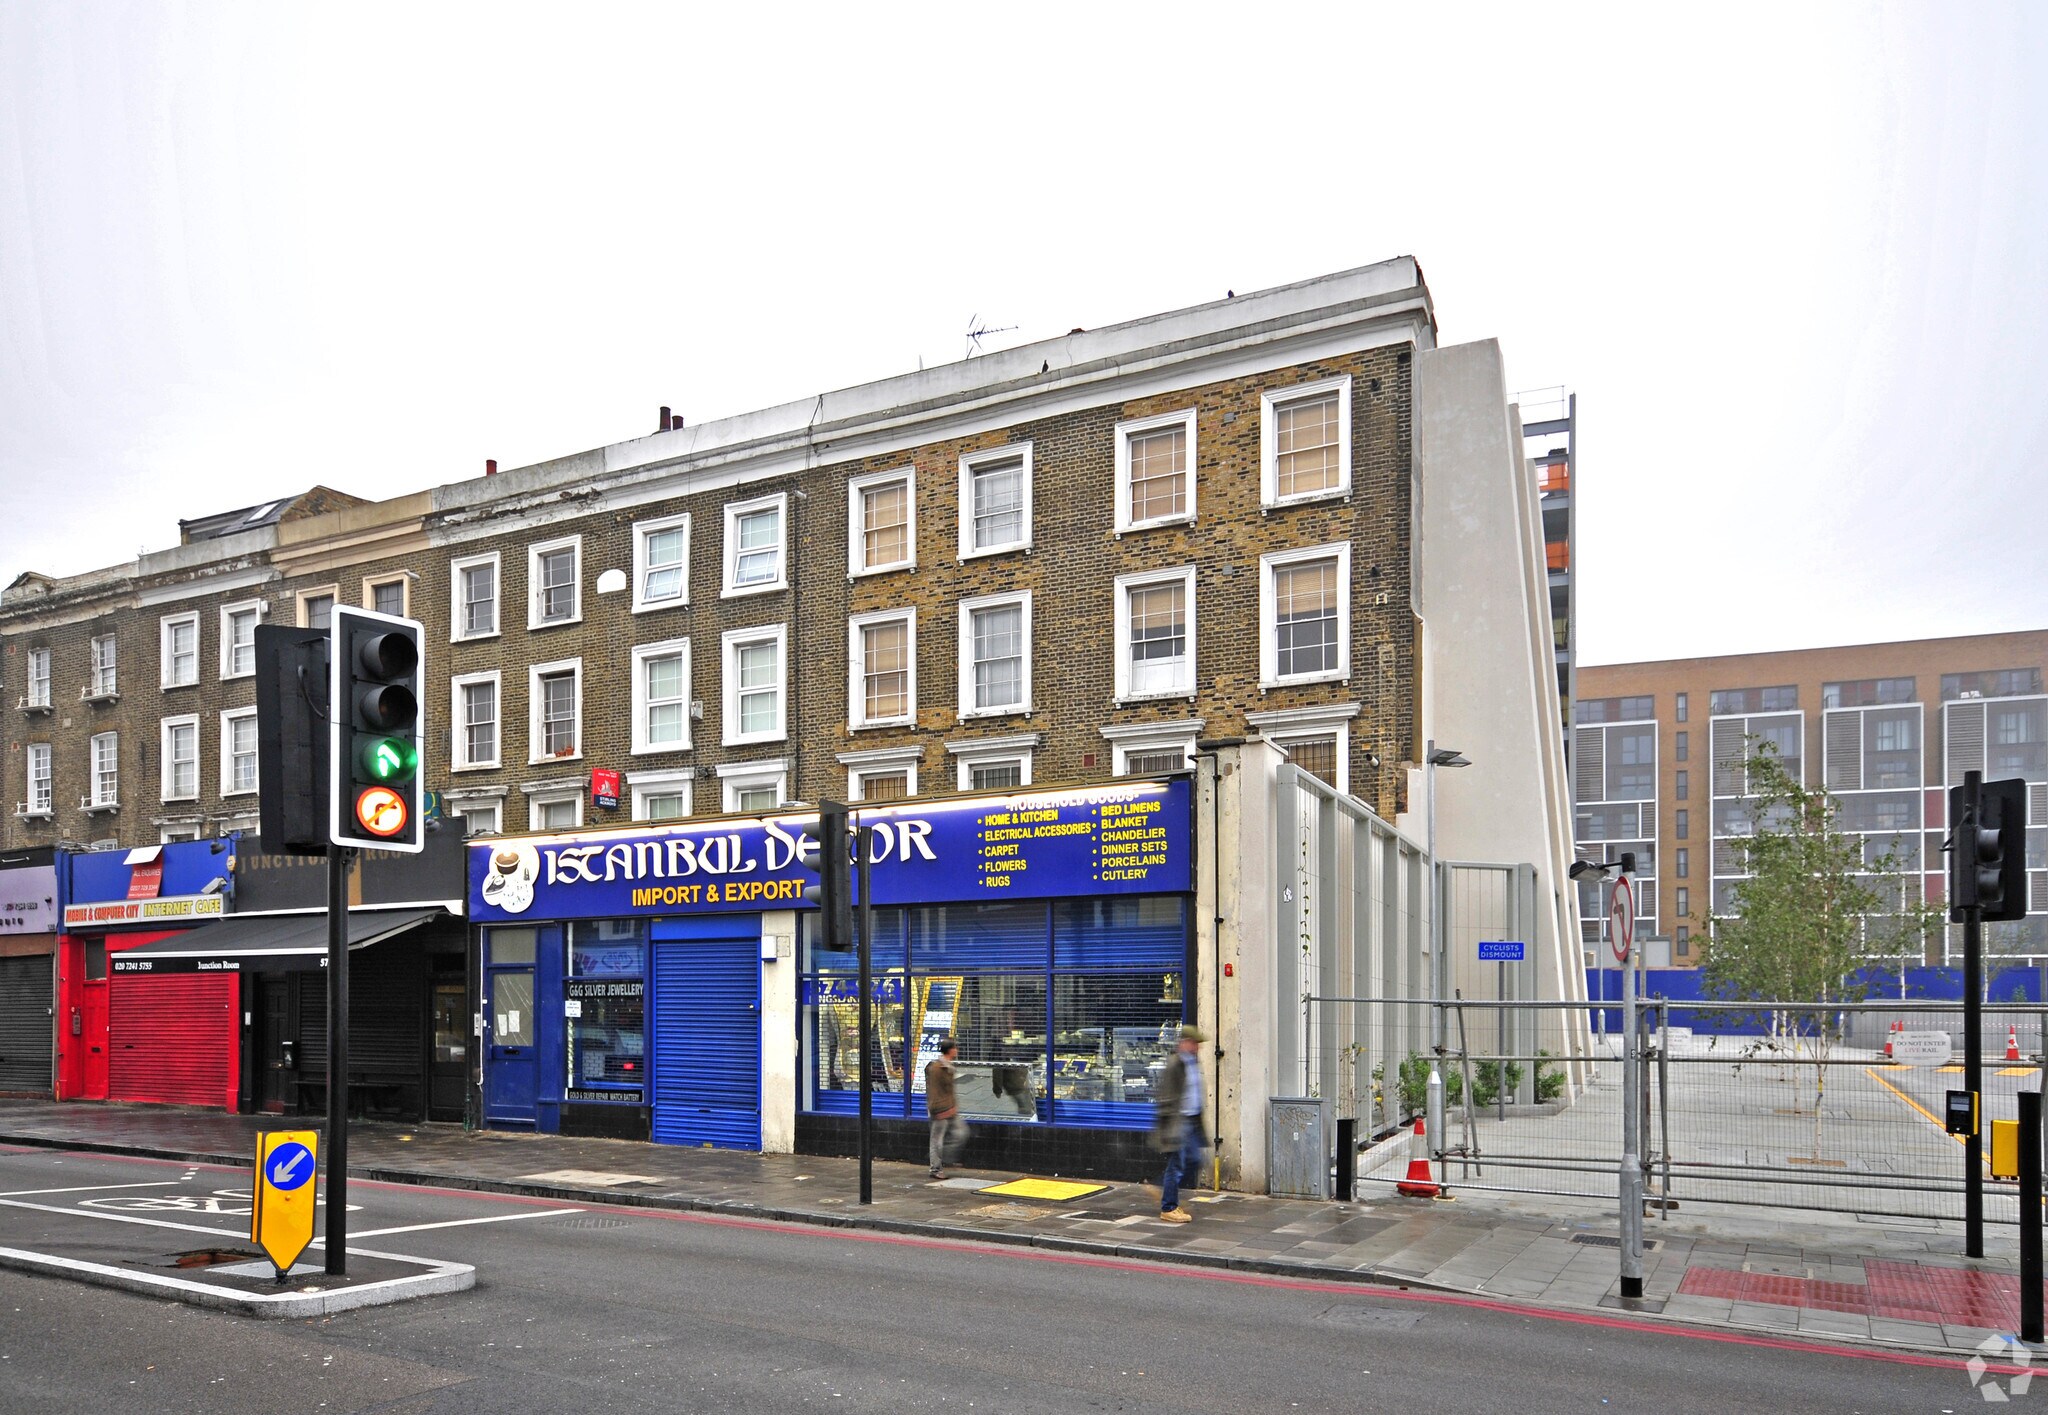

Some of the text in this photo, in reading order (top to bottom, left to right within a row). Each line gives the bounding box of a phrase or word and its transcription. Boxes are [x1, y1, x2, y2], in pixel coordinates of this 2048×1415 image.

[1101, 801, 1161, 817] BED LINENS
[985, 809, 1059, 826] HOME & KITCHEN
[1101, 816, 1148, 829] BLANKET
[985, 822, 1091, 842] ELECTRICAL ACCESSORIES
[1101, 828, 1166, 842] CHANDELIER
[985, 844, 1019, 857] CARPET
[1101, 840, 1168, 855] DINNER SETS
[544, 834, 757, 886] ISTANBUL
[985, 859, 1027, 873] FLOWERS
[1101, 854, 1166, 868] PORCELAINS
[986, 875, 1011, 888] RUGS
[1101, 869, 1148, 881] CUTLERY
[632, 879, 805, 907] IMPORT & EXPORT
[66, 904, 140, 923] MOBILE & COMPUTER CITY
[144, 898, 221, 918] INTERNET CAFE
[115, 962, 125, 971] 020
[197, 960, 240, 970] Junction Room
[569, 984, 584, 997] G&G
[607, 983, 644, 996] JEWELLERY
[569, 1091, 579, 1099] GOLD
[623, 1093, 640, 1101] BATTERY
